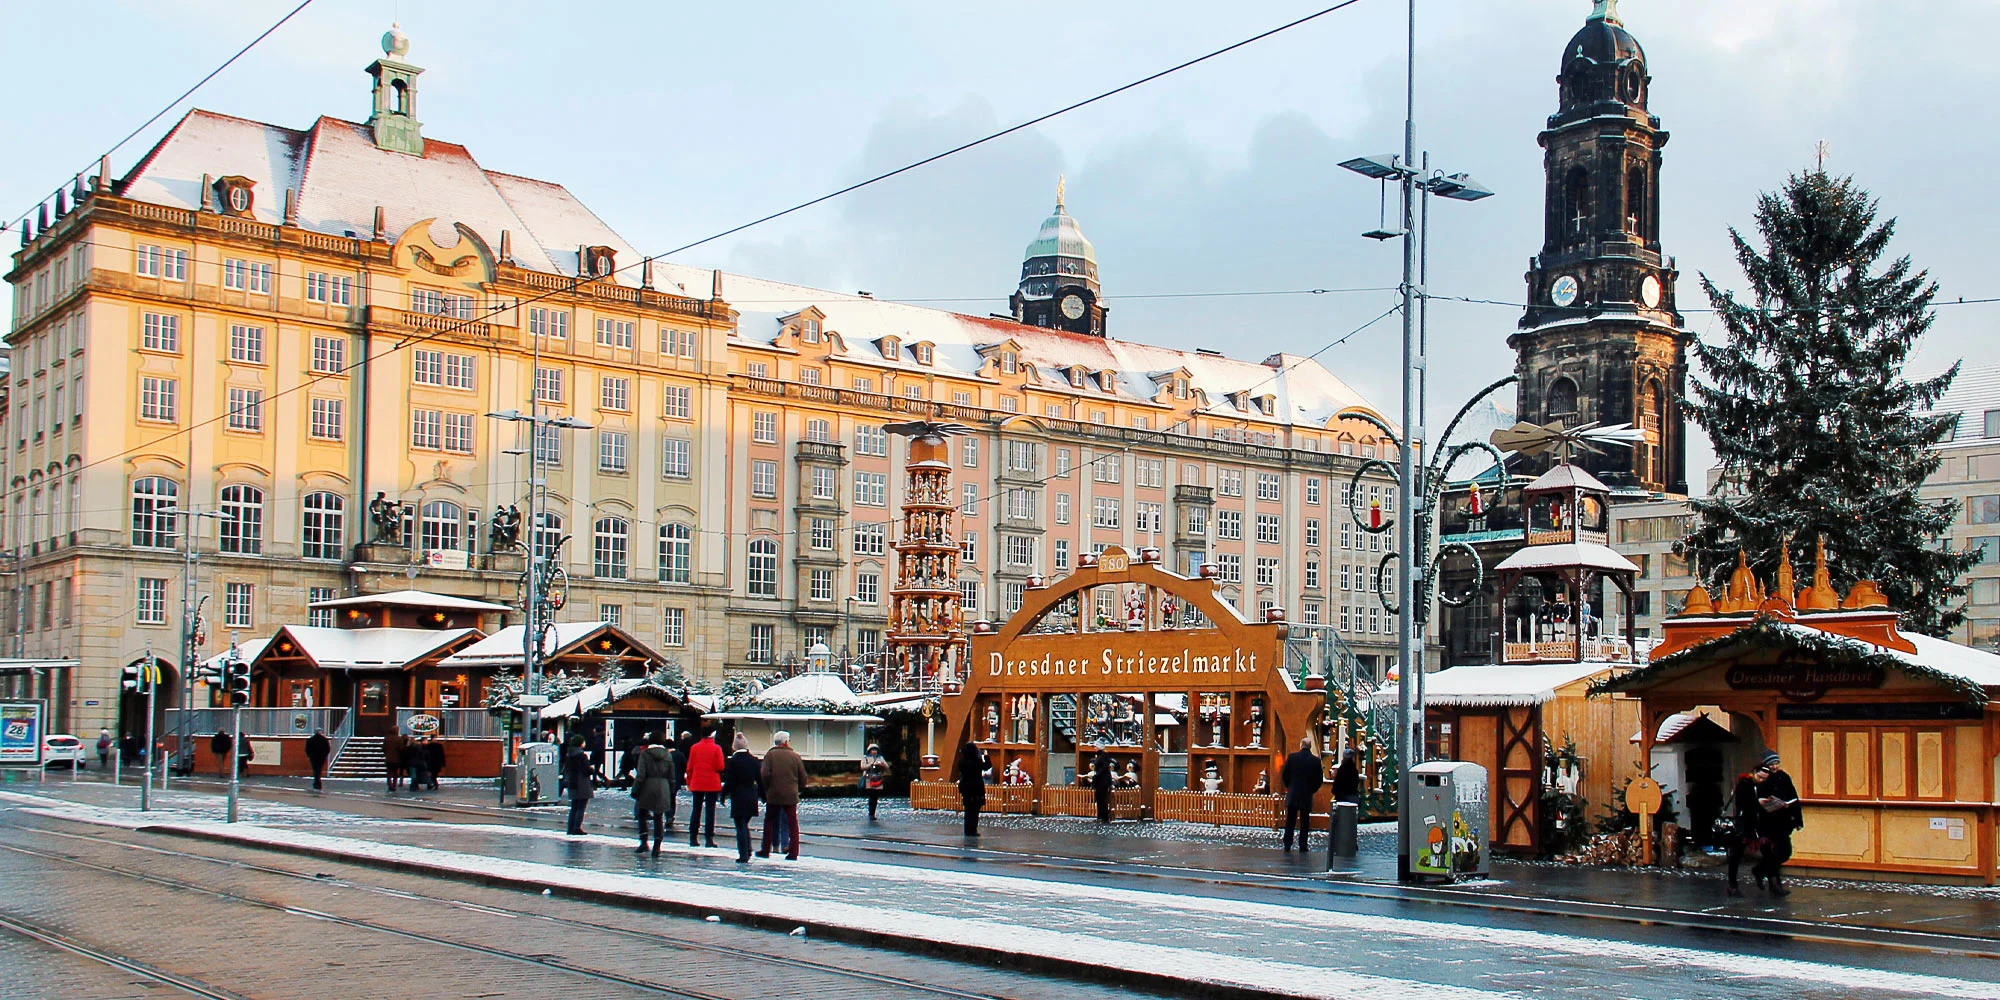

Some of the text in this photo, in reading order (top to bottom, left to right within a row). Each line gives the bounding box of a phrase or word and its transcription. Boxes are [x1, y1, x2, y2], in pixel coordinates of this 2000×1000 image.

[989, 647, 1258, 677] Dresdner Striezelmarkt
[1732, 668, 1873, 684] Dresdner Handbrot
[9, 725, 26, 735] 28.
